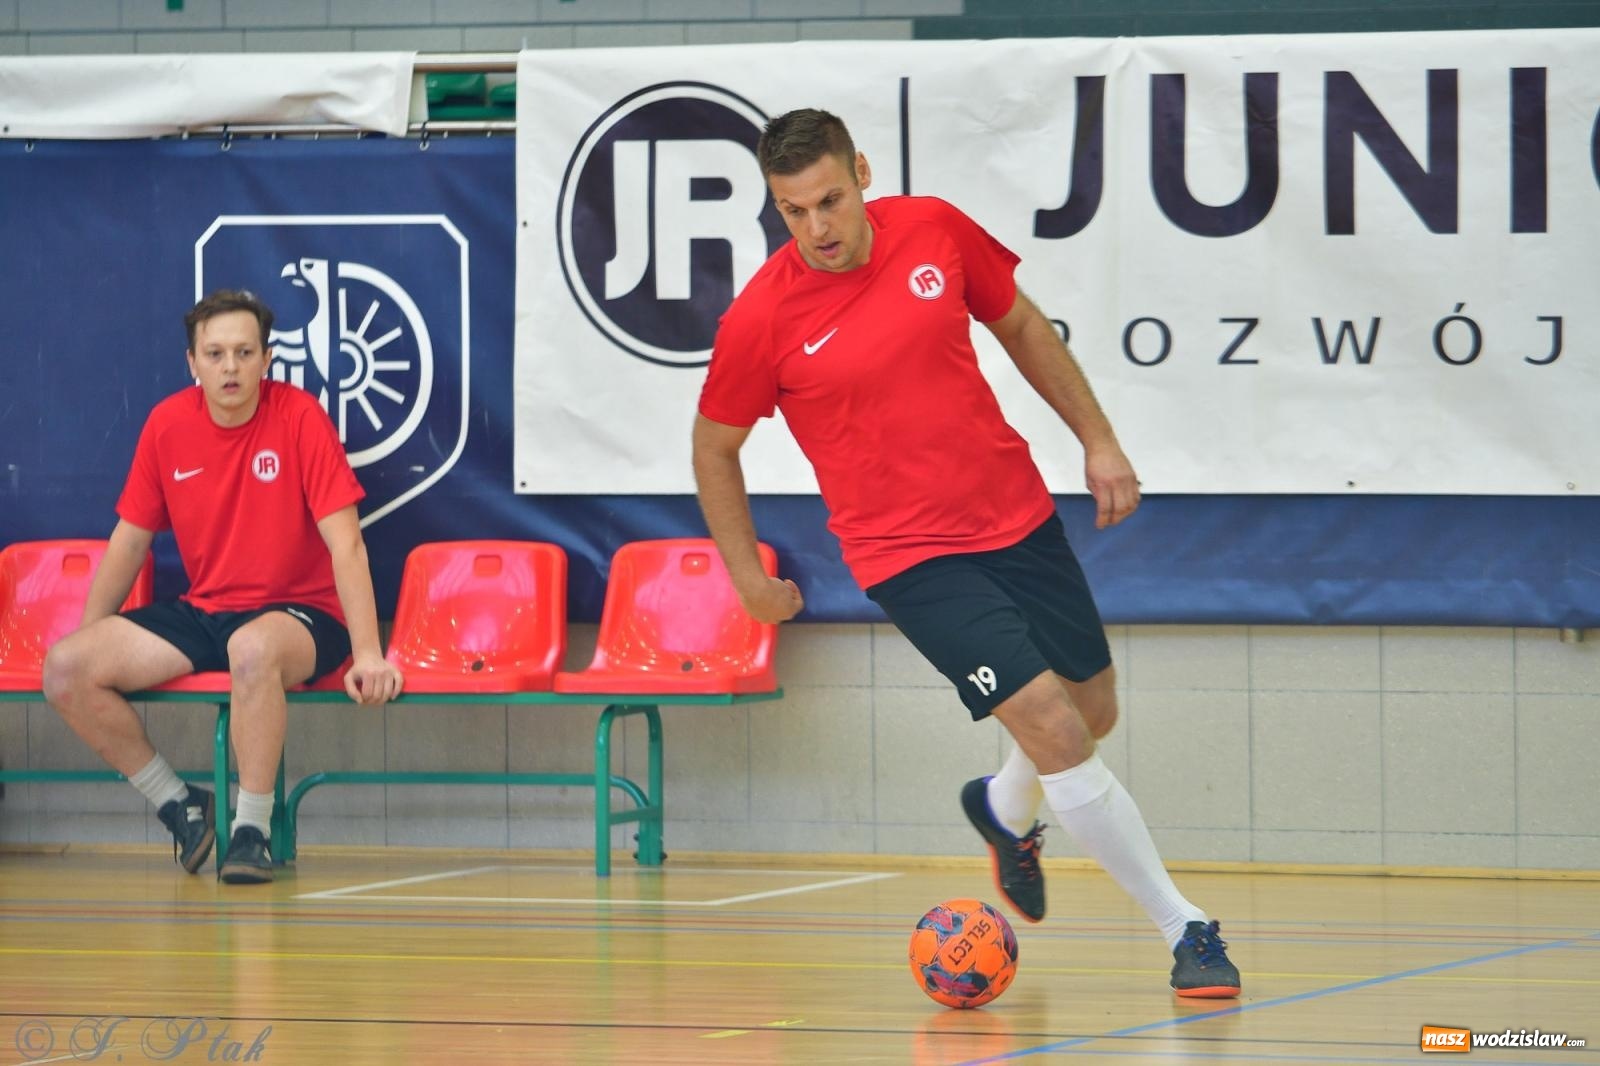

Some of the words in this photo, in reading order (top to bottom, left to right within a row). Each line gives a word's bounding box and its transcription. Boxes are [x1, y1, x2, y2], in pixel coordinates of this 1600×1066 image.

[605, 139, 768, 300] JR
[1033, 66, 1600, 239] JUNI
[966, 665, 997, 696] 19
